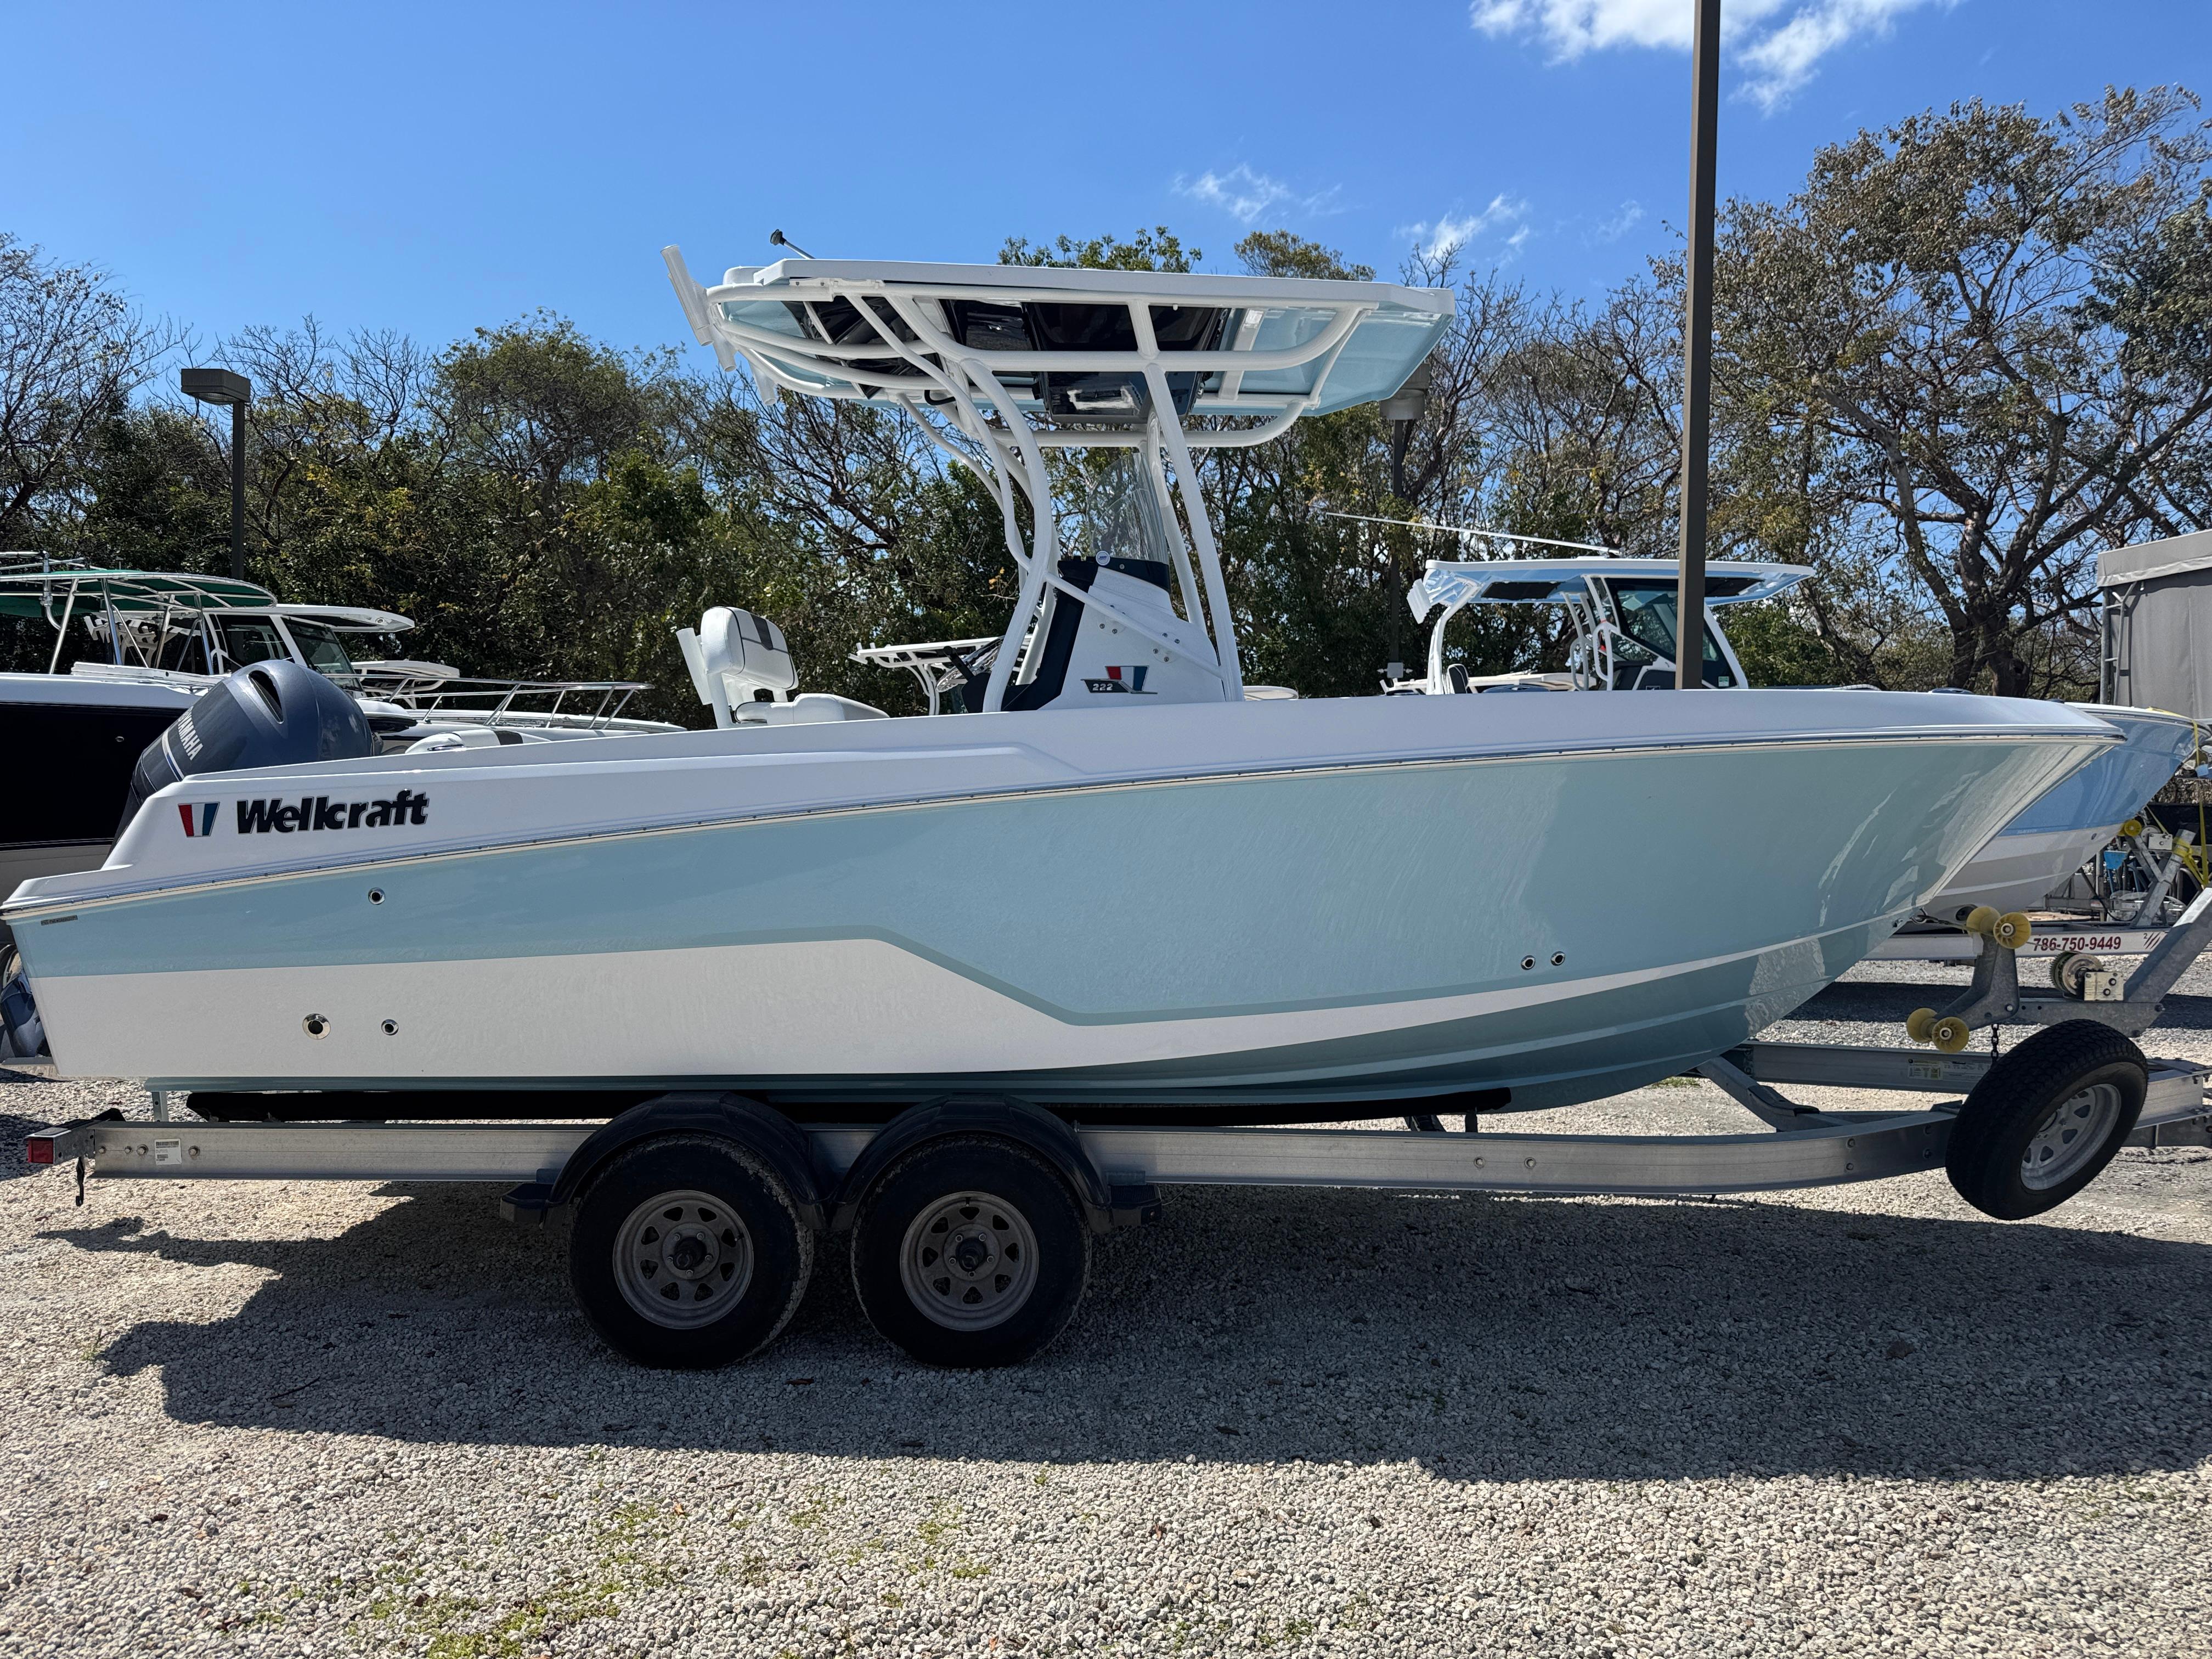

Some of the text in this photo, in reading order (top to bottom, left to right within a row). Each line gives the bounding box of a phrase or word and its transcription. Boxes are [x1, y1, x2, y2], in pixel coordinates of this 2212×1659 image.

[1092, 683, 1113, 691] 222
[178, 712, 203, 761] YAMAHA
[236, 789, 430, 834] Wellcraft
[2033, 936, 2121, 952] 786-750-9449
